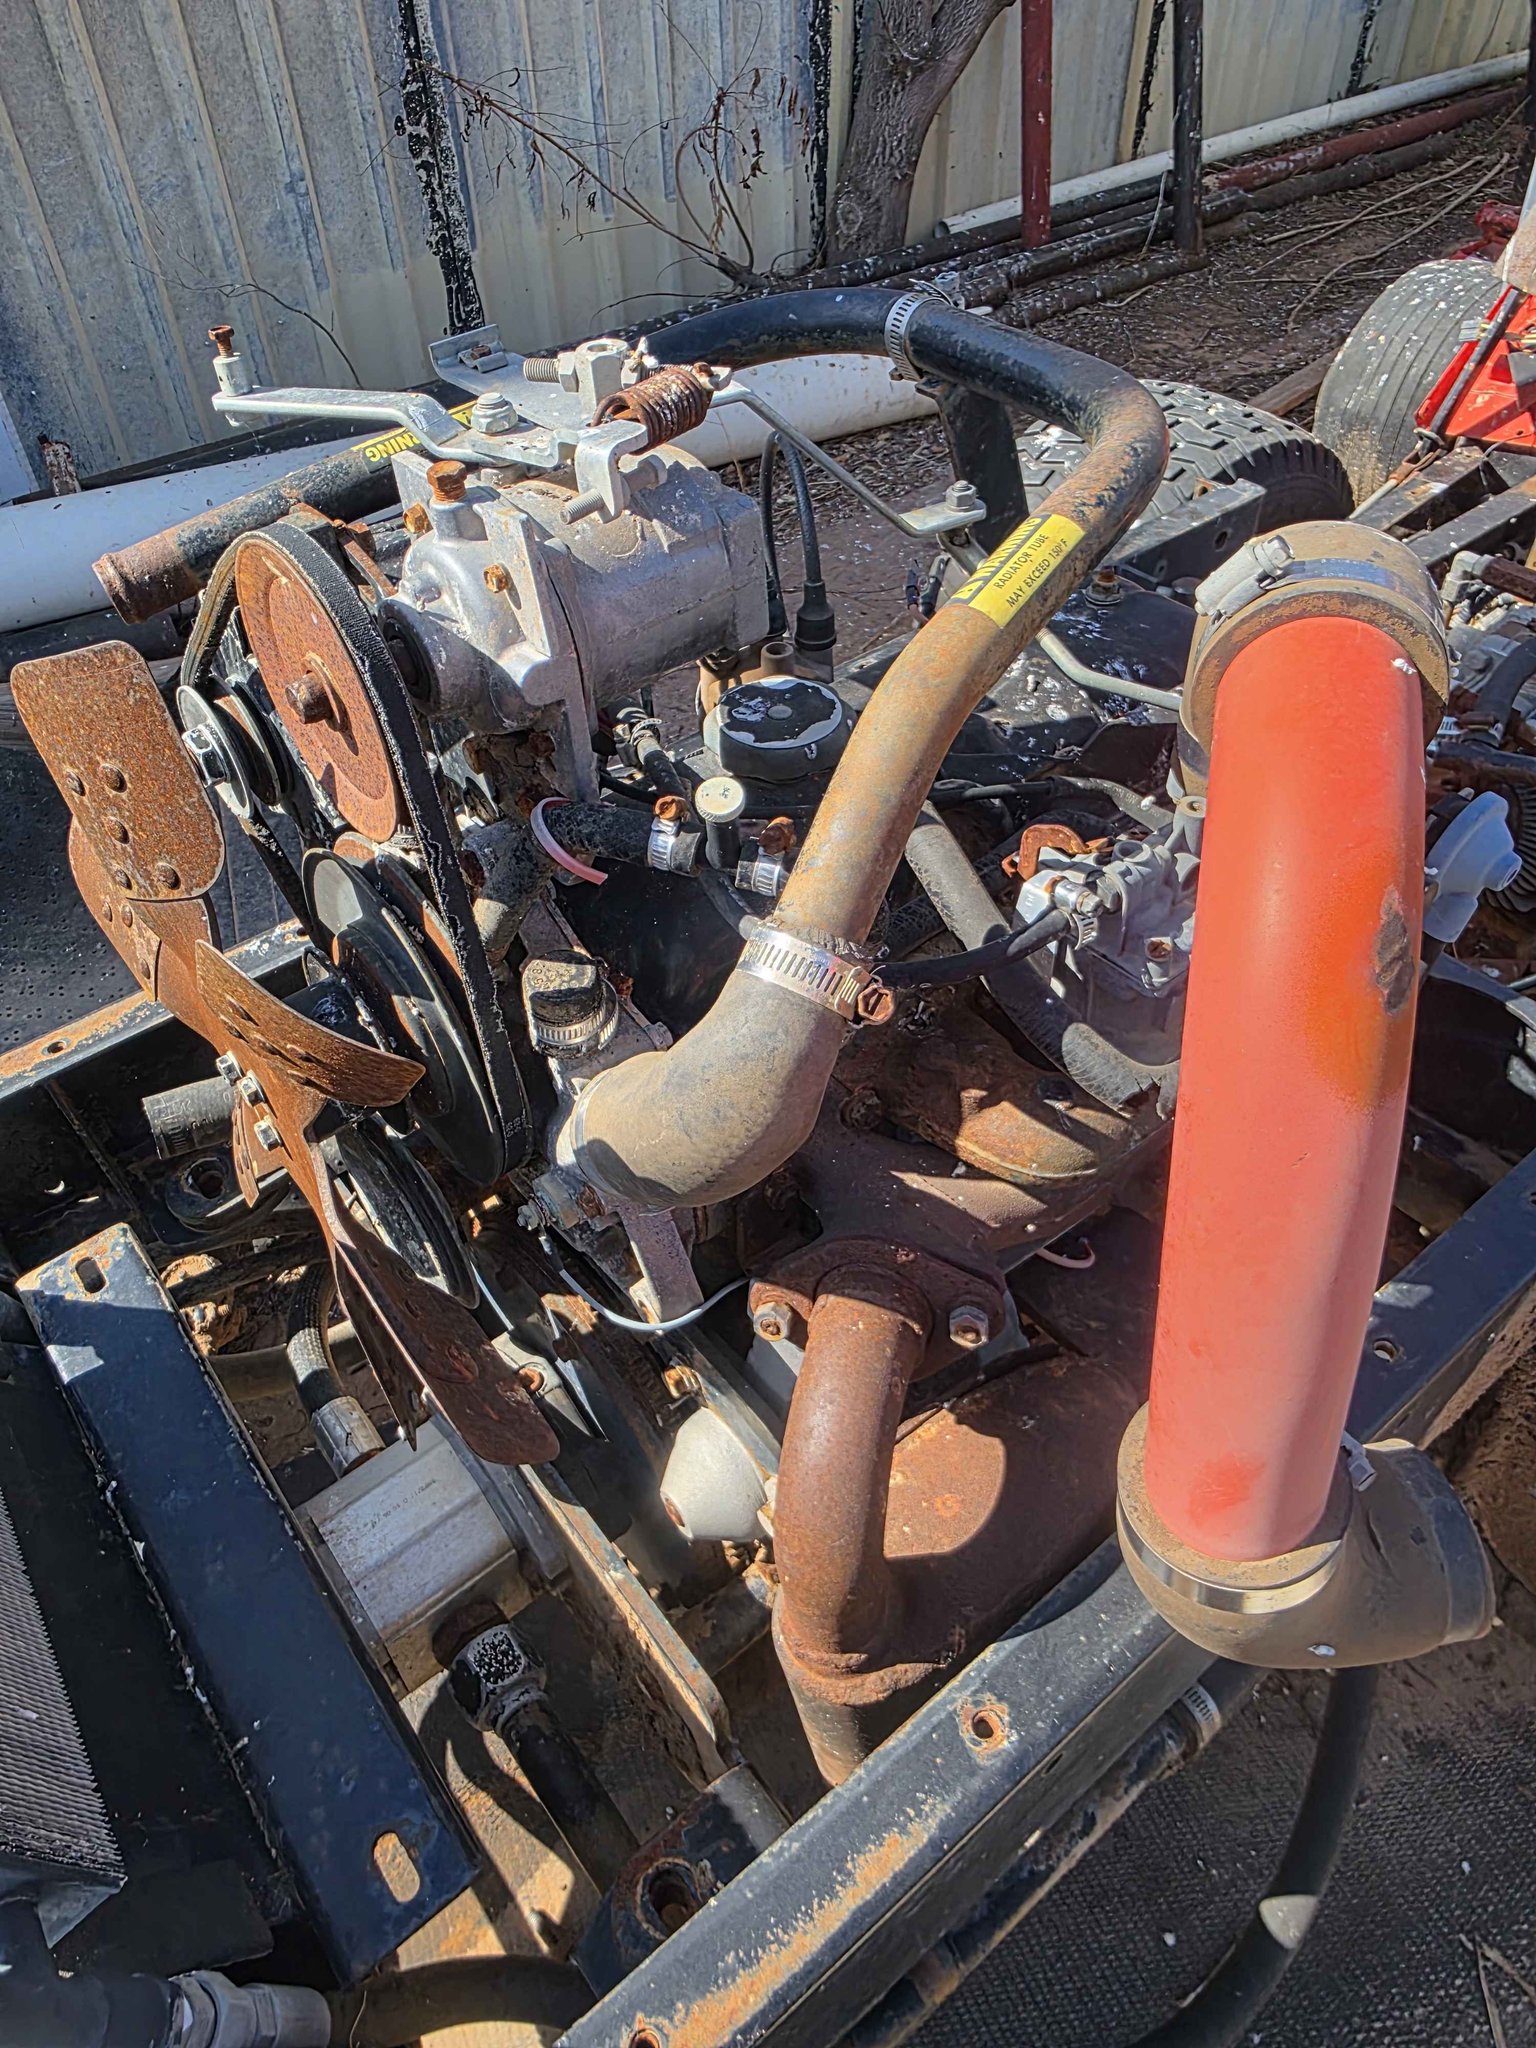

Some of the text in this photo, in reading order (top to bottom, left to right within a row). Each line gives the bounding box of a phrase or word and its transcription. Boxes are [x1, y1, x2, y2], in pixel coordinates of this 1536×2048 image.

[994, 534, 1049, 589] RADIATOR TUBE
[1006, 585, 1026, 607] MAY
[1023, 559, 1050, 588] EXCEED
